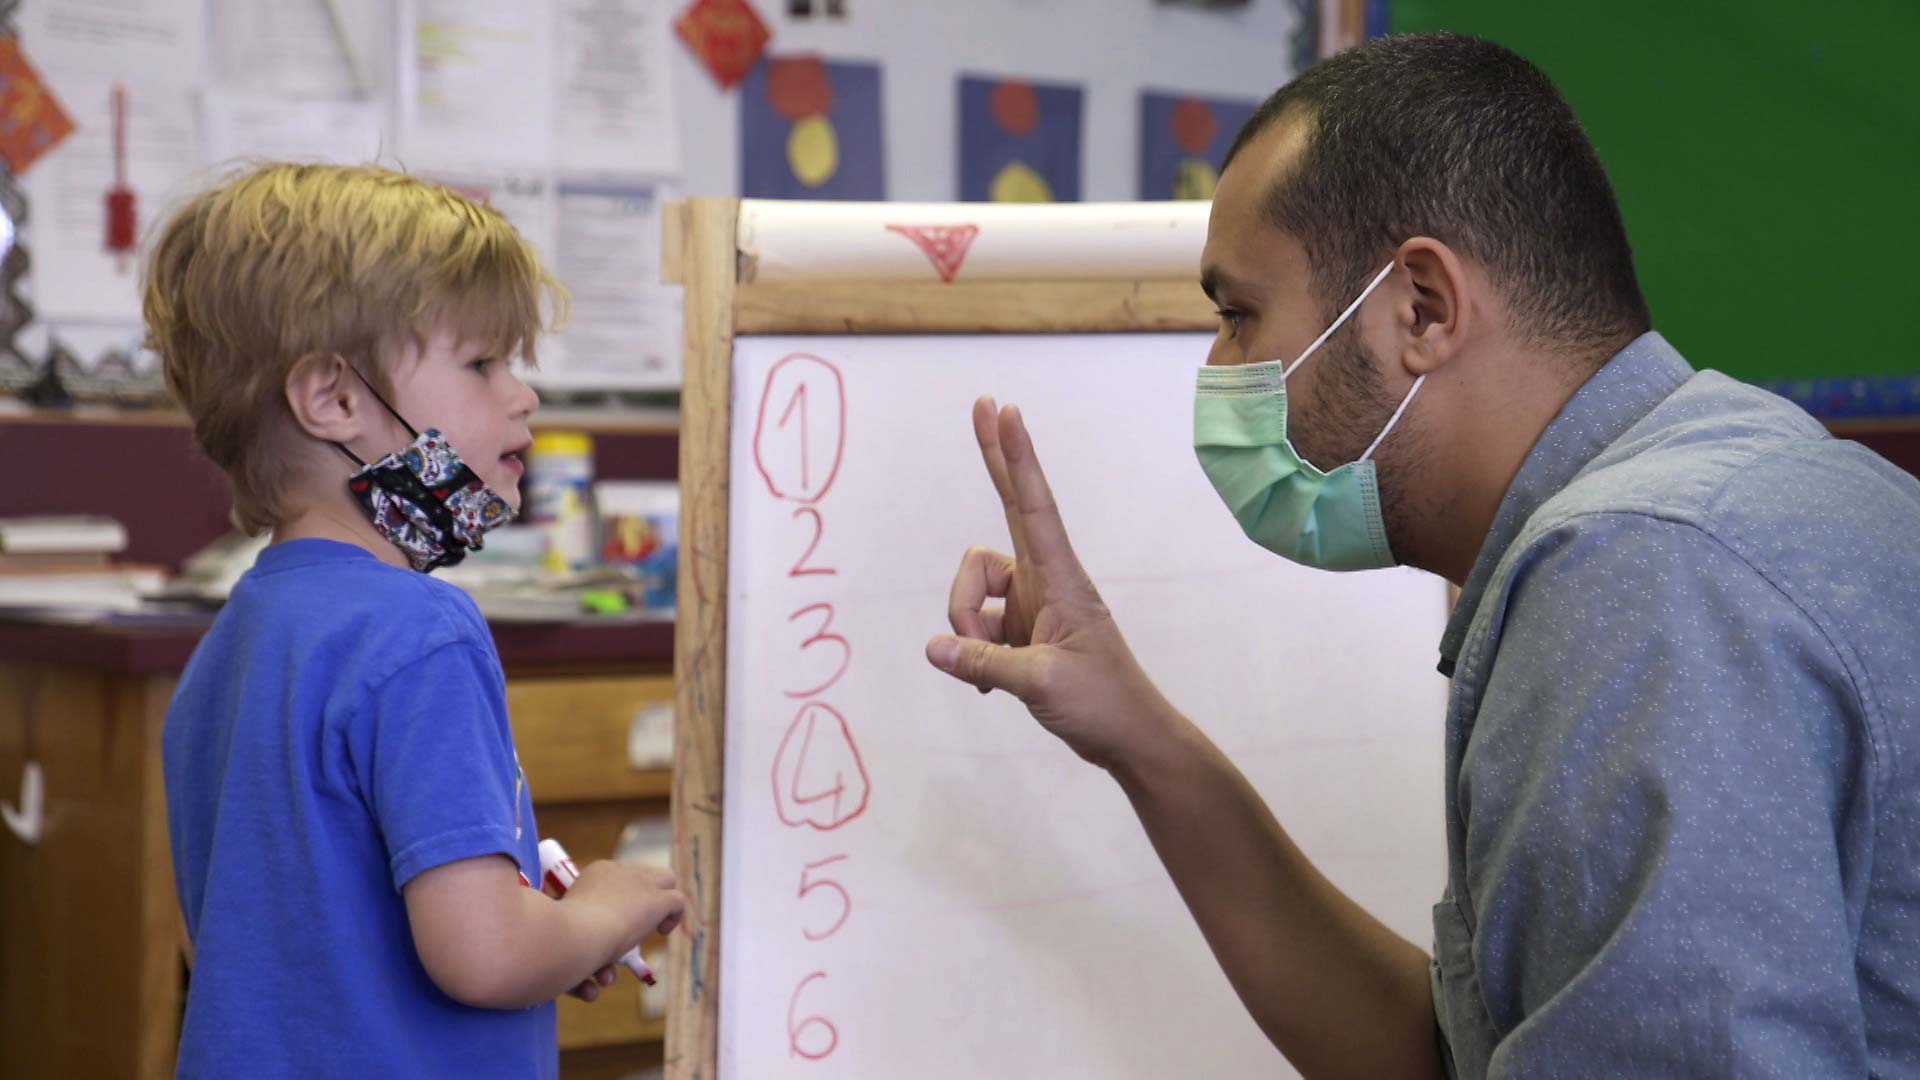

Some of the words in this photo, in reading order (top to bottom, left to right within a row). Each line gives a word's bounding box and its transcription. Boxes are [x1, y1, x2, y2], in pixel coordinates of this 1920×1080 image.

[778, 382, 807, 490] 1
[788, 507, 837, 577] 2
[784, 603, 850, 699] 3
[792, 711, 844, 823] 4
[798, 854, 850, 941] 5
[788, 971, 838, 1060] 6
